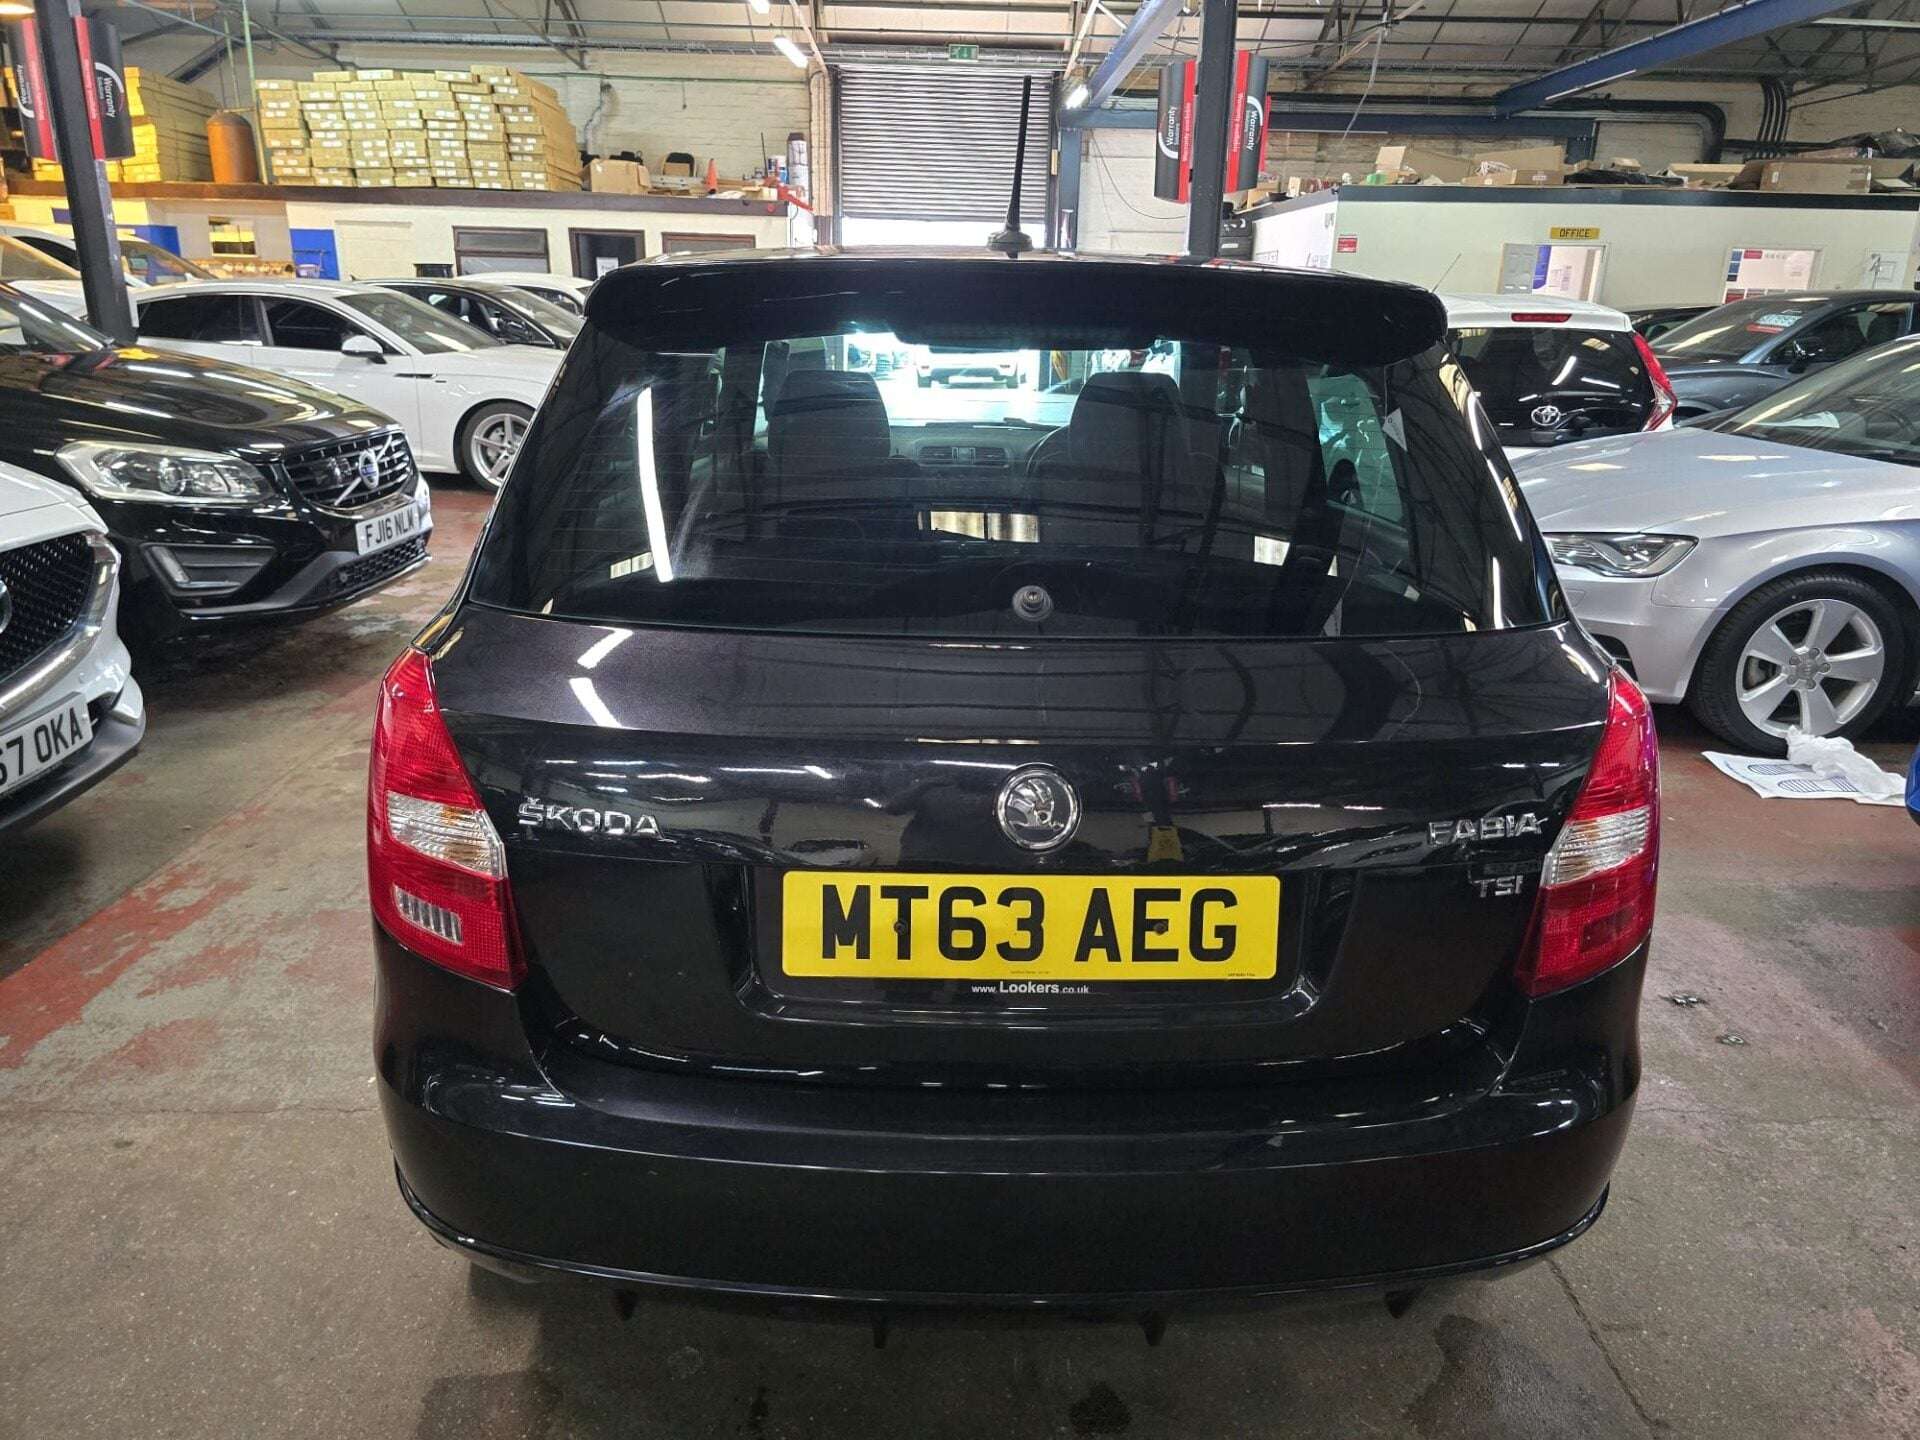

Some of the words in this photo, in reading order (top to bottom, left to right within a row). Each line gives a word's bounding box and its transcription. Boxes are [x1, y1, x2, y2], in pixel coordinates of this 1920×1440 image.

[103, 77, 115, 118] Warranty
[1166, 106, 1178, 146] Warranty
[1246, 110, 1258, 151] Warranty
[1559, 228, 1592, 238] OFFICE
[365, 518, 393, 547] FJ16
[34, 707, 83, 763] OKA
[518, 796, 665, 838] ŠKODA
[1428, 813, 1542, 846] FABIA
[1473, 875, 1524, 898] TSI
[822, 884, 1045, 962] MT63
[1074, 887, 1238, 963] AEG
